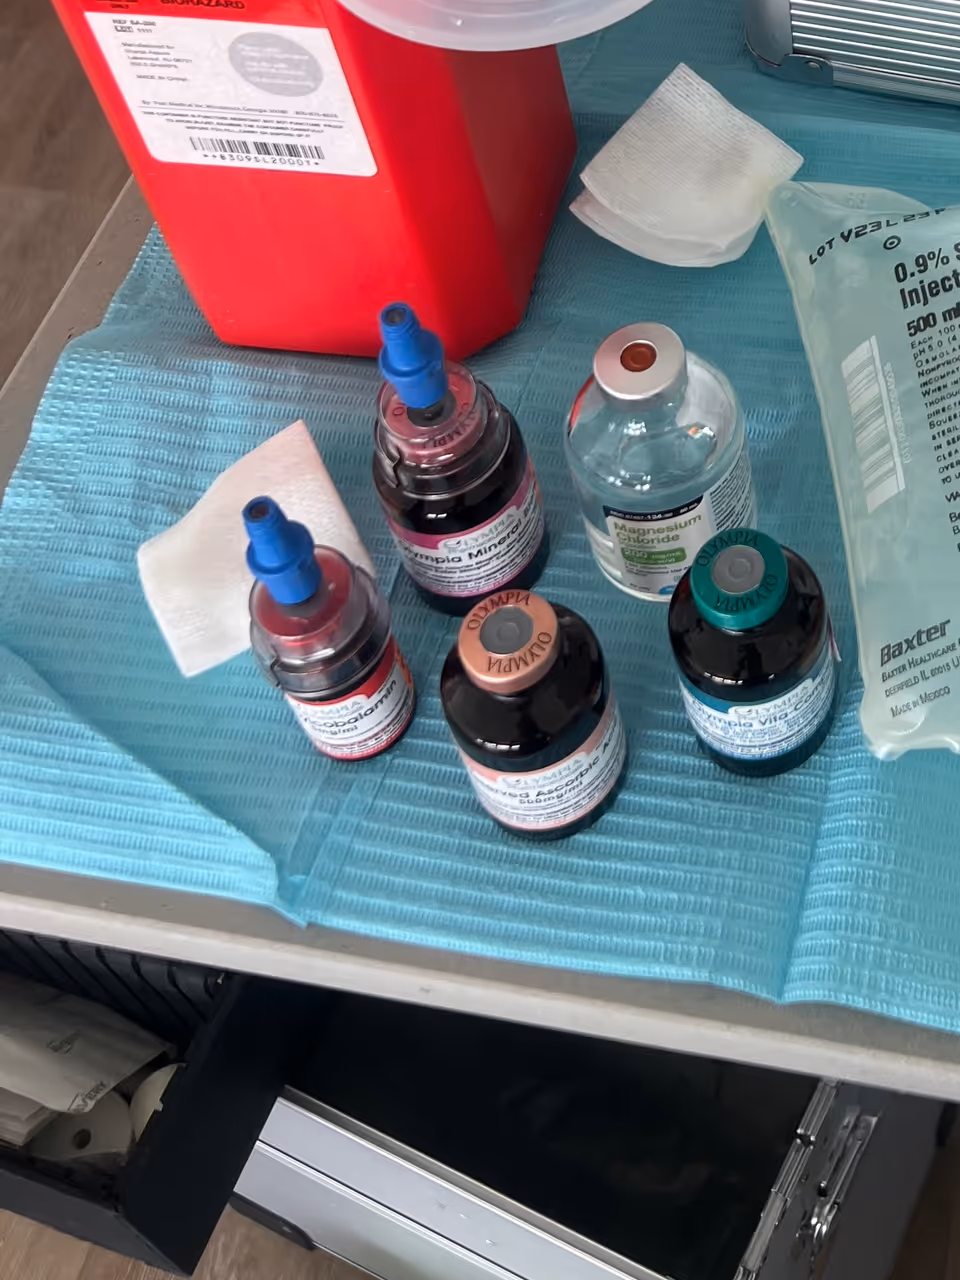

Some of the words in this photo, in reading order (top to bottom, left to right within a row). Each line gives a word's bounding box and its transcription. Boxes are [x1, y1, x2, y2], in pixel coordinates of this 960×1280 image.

[808, 237, 835, 265] LOT
[894, 248, 950, 283] 0.9%
[906, 312, 938, 338] 500
[401, 540, 462, 565] lympia
[468, 520, 522, 561] Mineral
[613, 514, 702, 536] Magnesium
[616, 531, 680, 545] Chloride
[697, 530, 758, 568] OLYMPIA
[467, 592, 530, 631] OLYMPIA
[487, 631, 552, 674] OLYMPIA
[880, 619, 951, 668] Baxter
[881, 663, 907, 683] BAXTER
[907, 642, 957, 670] HEALTHCARE
[884, 675, 920, 698] DEERFIELD
[920, 669, 930, 681] IL
[890, 702, 912, 718] MADE
[920, 685, 951, 705] MEXICO
[536, 757, 600, 798] Ascorbic
